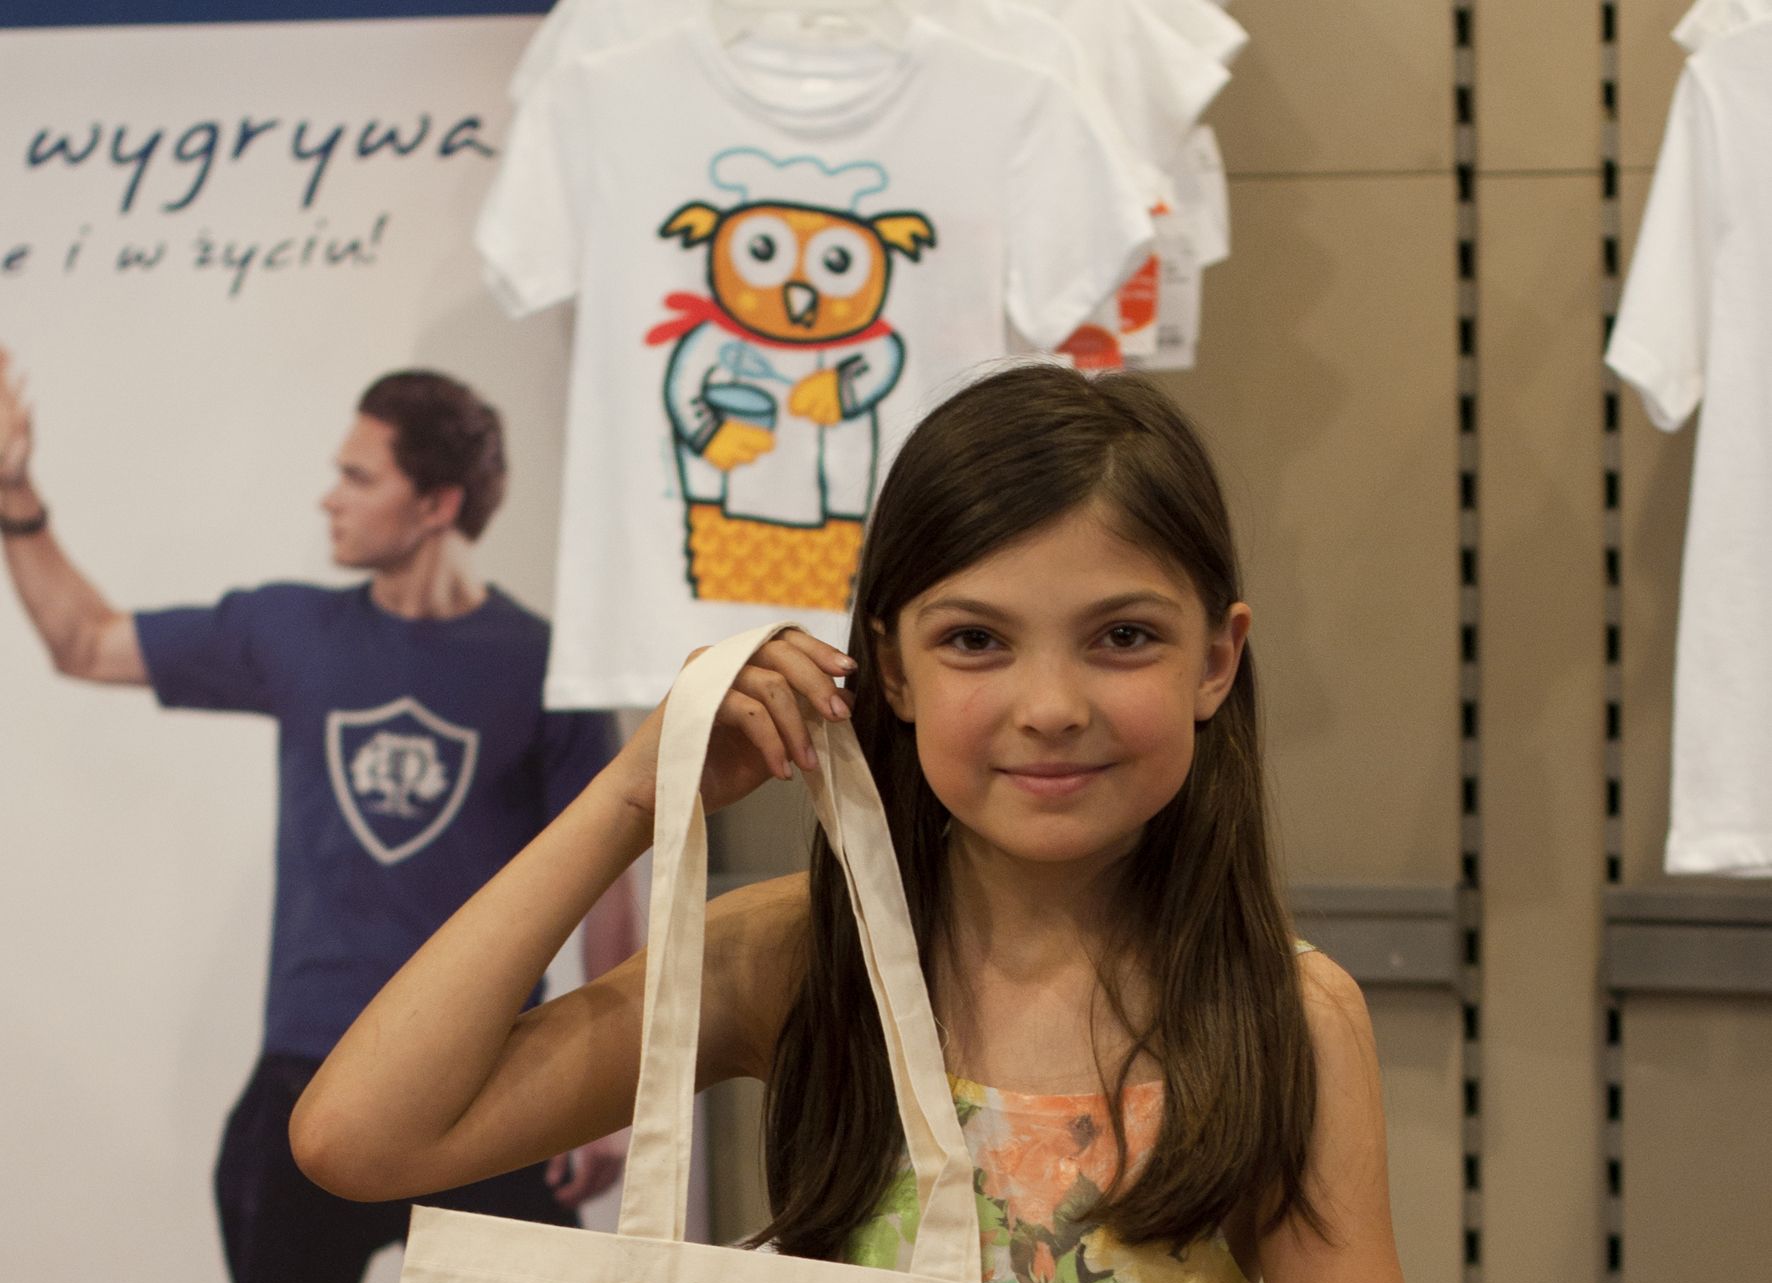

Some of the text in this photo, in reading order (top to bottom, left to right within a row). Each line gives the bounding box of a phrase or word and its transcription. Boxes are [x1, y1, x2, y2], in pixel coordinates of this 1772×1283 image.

[26, 113, 499, 213] wygrywa
[64, 224, 91, 271] i
[116, 242, 166, 271] w
